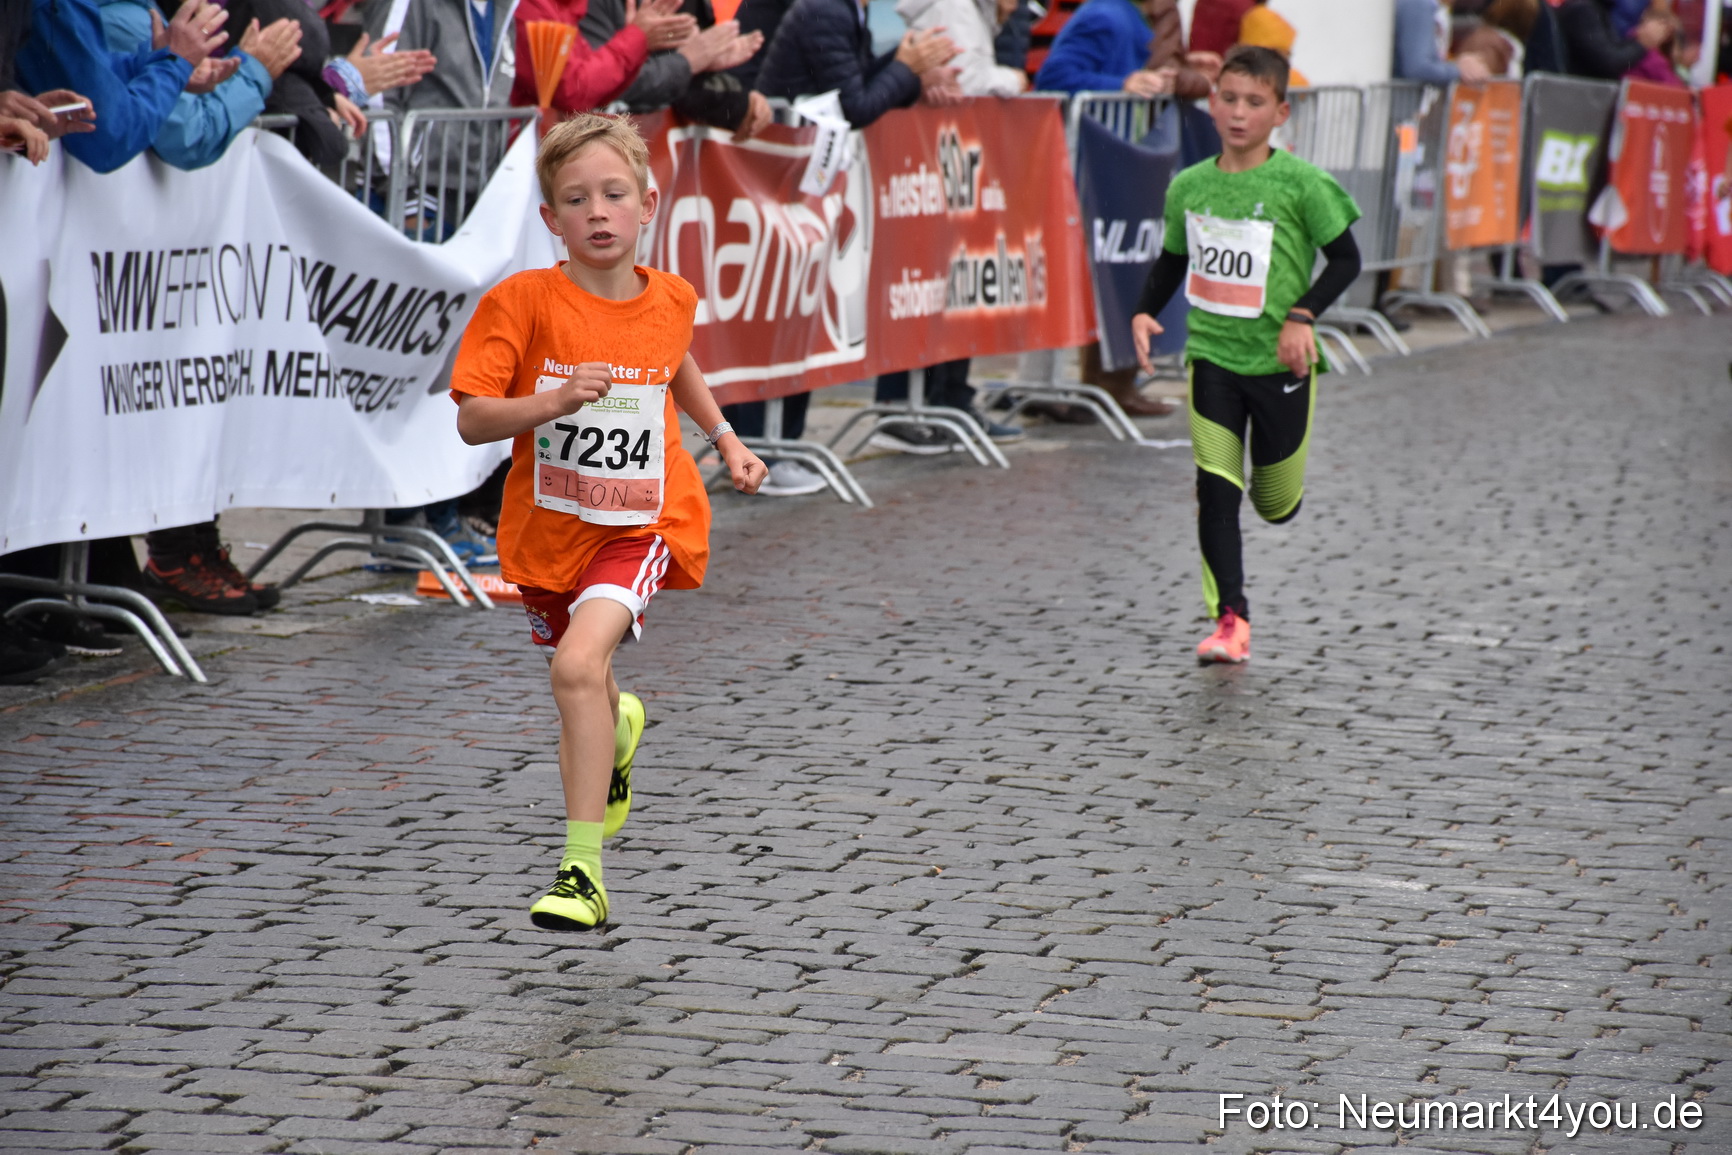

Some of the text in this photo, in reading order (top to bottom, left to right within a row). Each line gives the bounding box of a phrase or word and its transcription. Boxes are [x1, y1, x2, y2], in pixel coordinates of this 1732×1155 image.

[591, 396, 640, 410] BOCK
[555, 422, 651, 470] 7234
[564, 474, 629, 507] LEON
